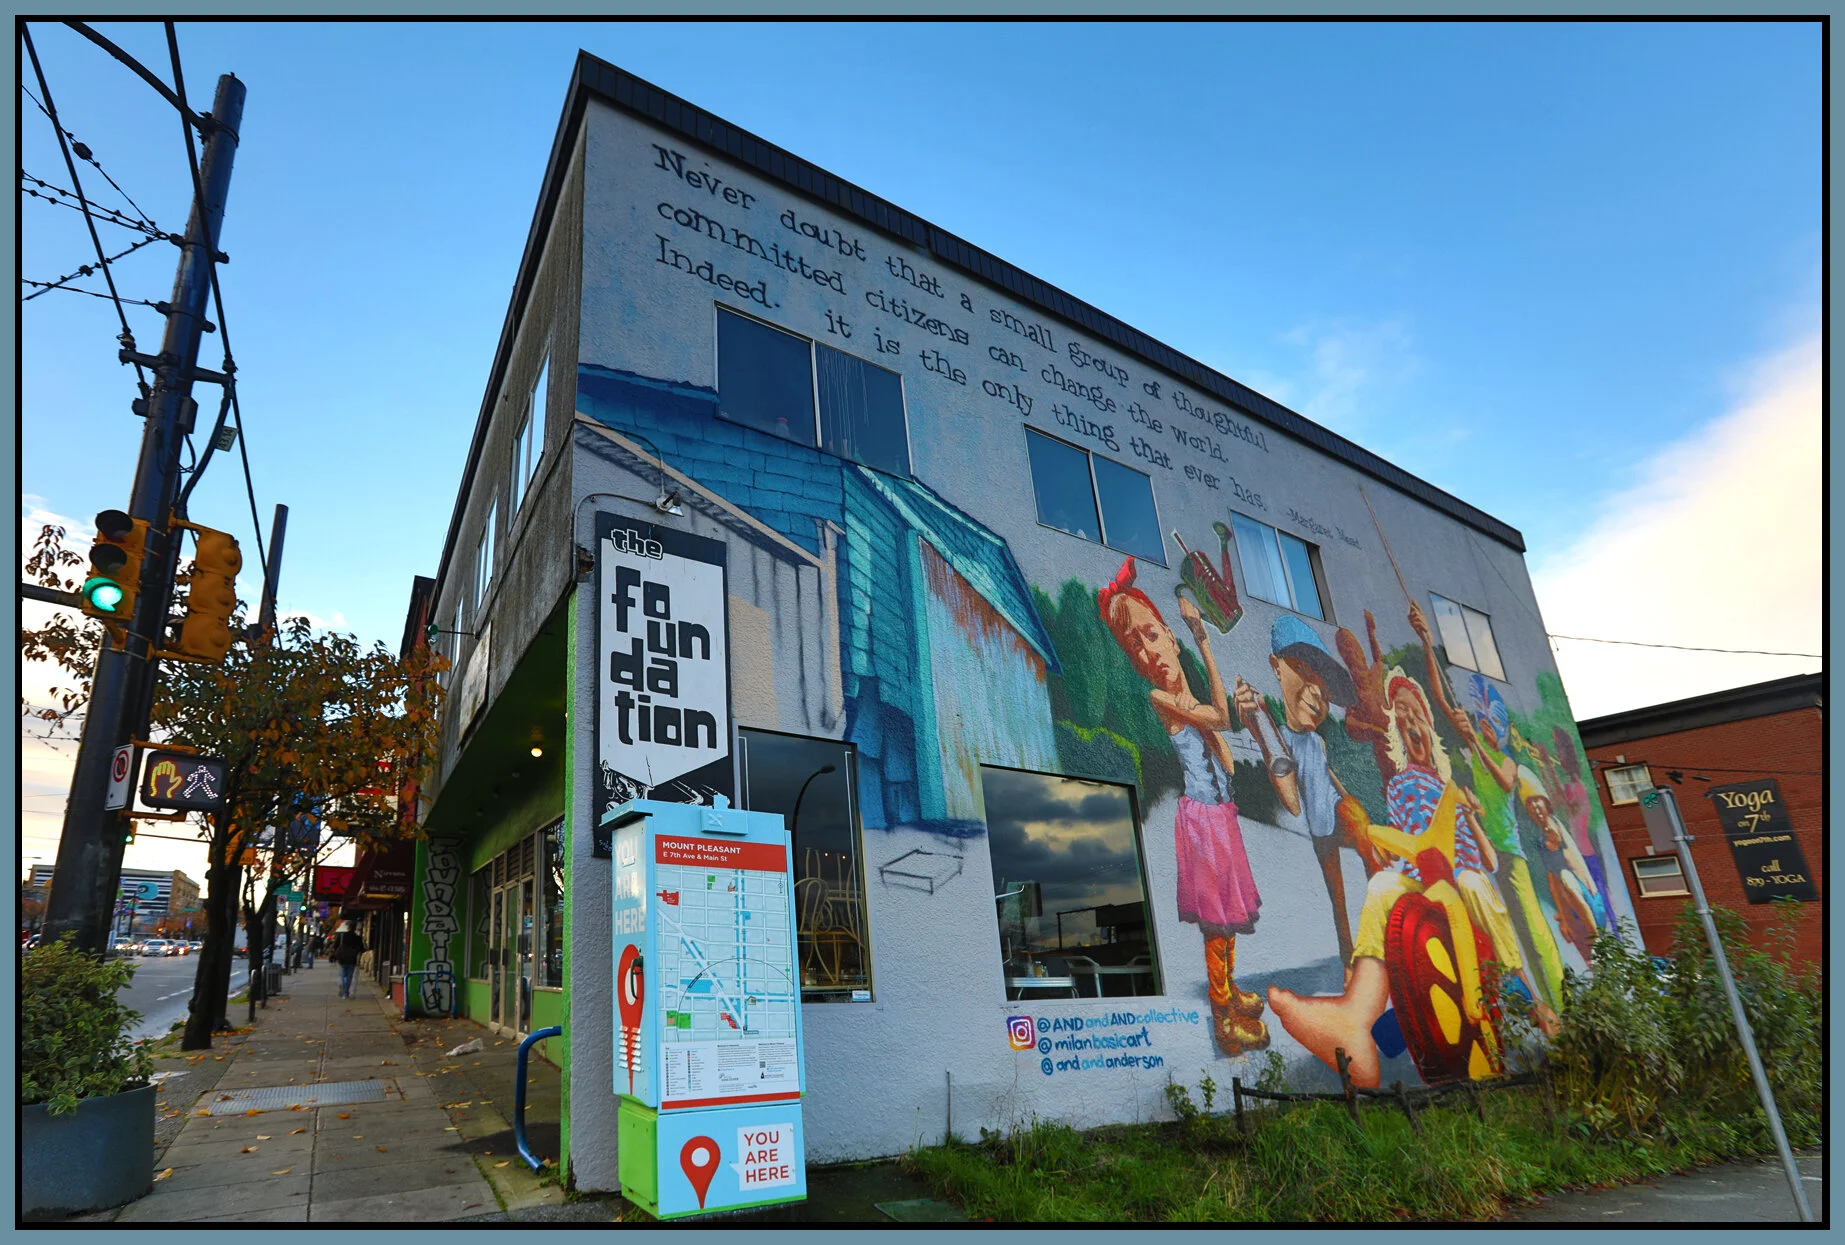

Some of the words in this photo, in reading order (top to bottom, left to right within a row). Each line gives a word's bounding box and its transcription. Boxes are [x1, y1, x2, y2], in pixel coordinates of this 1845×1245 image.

[652, 144, 756, 209] Never
[780, 210, 866, 262] doubt
[885, 255, 945, 299] that
[960, 293, 975, 314] a
[990, 308, 1057, 353] small
[1068, 342, 1129, 388] group
[1143, 381, 1161, 400] of
[1172, 391, 1269, 453] thoughtful
[657, 202, 846, 295] committed
[865, 289, 969, 346] citizens
[988, 344, 1028, 373] can
[1041, 364, 1116, 414] change
[1127, 402, 1163, 434] the
[1170, 424, 1229, 463] world.
[655, 234, 781, 309] Indeed.
[825, 309, 852, 339] it
[873, 327, 900, 355] is
[919, 349, 967, 386] the
[982, 378, 1033, 416] only
[1051, 403, 1120, 453] thing
[1130, 435, 1174, 471] that
[1184, 463, 1220, 491] ever
[1229, 477, 1267, 512] has.
[611, 529, 663, 560] the
[1717, 789, 1776, 812] Yoga
[662, 841, 695, 851] MOUNT
[697, 844, 741, 855] PLEASANT
[1761, 859, 1782, 873] call
[615, 905, 646, 935] HERE
[744, 1131, 780, 1146] YOU
[745, 1149, 779, 1164] ARE
[745, 1165, 790, 1183] HERE
